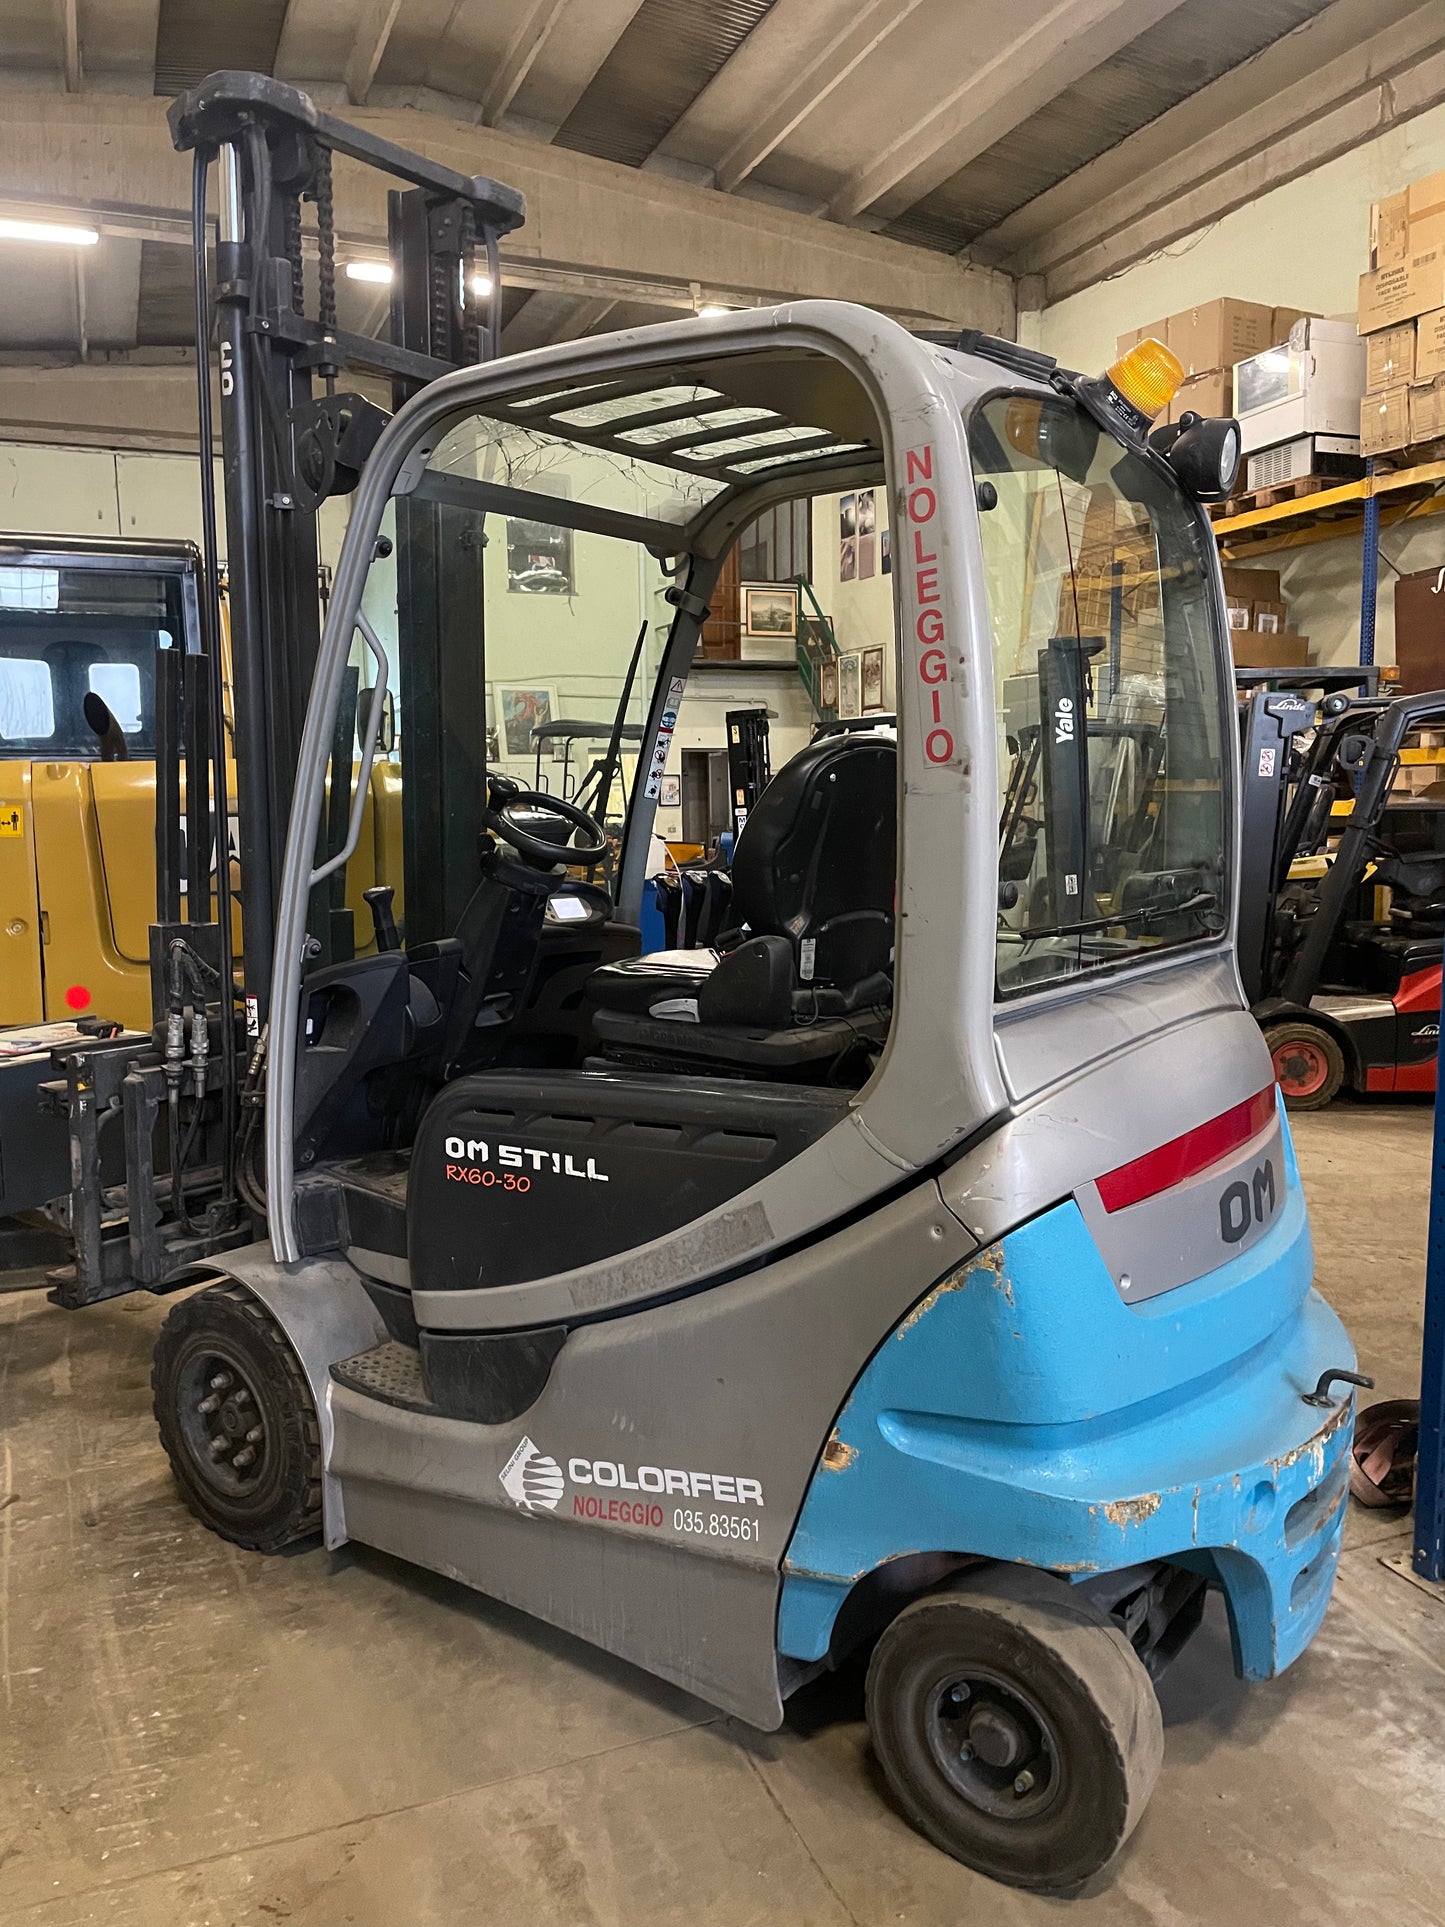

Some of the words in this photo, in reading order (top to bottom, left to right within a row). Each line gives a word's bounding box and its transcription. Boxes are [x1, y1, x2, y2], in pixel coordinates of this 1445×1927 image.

[906, 446, 953, 763] NOLEGGIO
[1055, 697, 1073, 744] Yale
[1268, 699, 1305, 711] Linde
[445, 1136, 489, 1162] OM
[498, 1144, 609, 1181] STILL
[445, 1164, 531, 1192] RX60-30
[1219, 1159, 1275, 1243] OM
[512, 1437, 530, 1460] GROUP
[568, 1457, 764, 1506] COLORFER
[573, 1495, 664, 1528] NOLEGGIO
[673, 1508, 760, 1542] 035.83561
